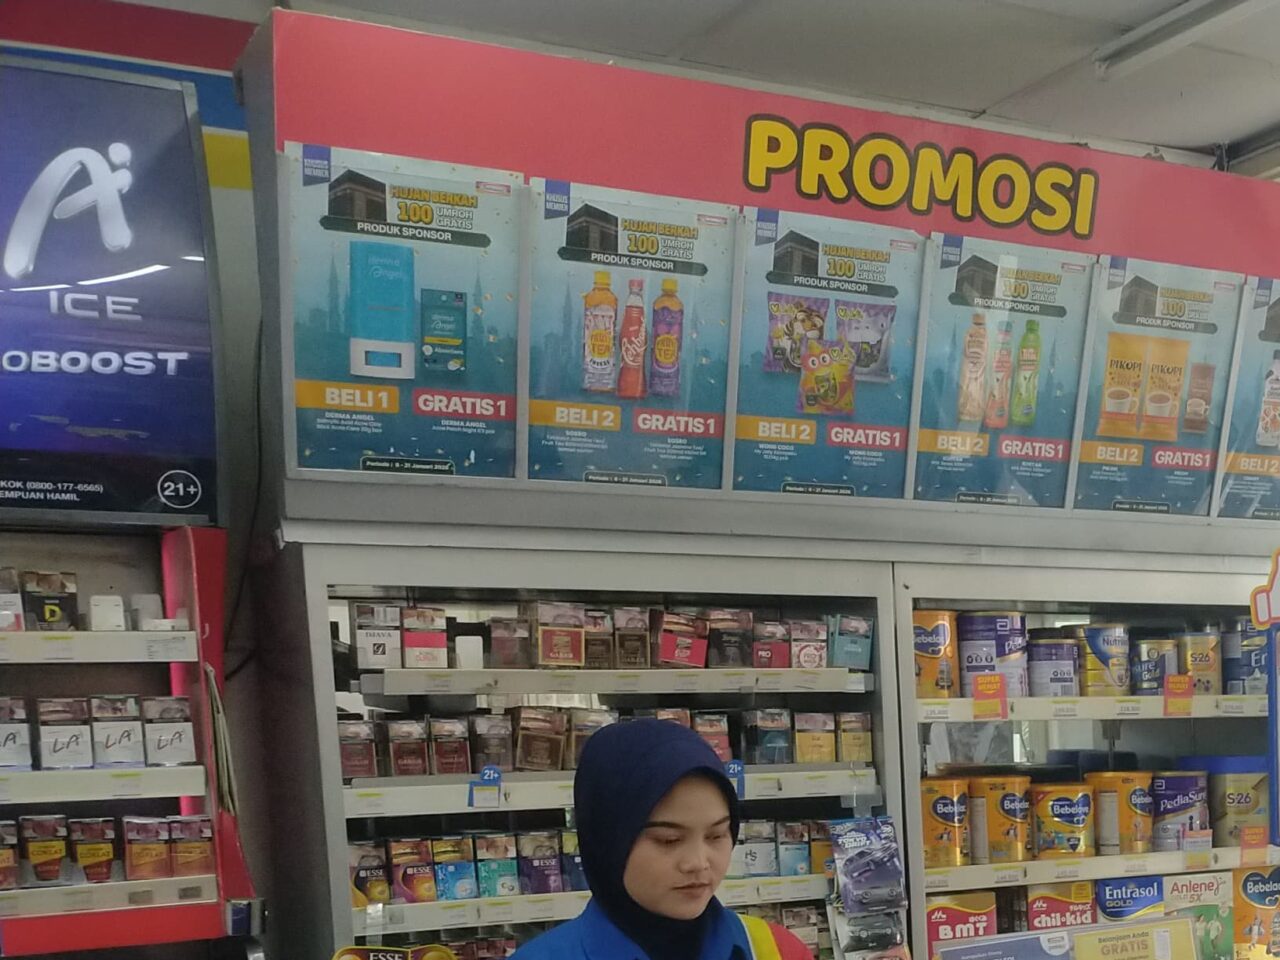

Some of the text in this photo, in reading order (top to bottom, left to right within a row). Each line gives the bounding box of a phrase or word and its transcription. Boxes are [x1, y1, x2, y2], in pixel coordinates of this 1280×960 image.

[743, 114, 1099, 239] PROMOSI
[389, 185, 478, 208] HUJAN BERKAH
[398, 202, 435, 225] 100
[436, 206, 474, 219] UMROH
[357, 221, 452, 242] PRODUK SPONSOR
[436, 217, 473, 229] GRATIS
[621, 218, 698, 239] HUJAN BERKAH
[628, 234, 659, 255] 100
[661, 247, 693, 259] GRATIS
[591, 252, 674, 270] PRODUK SPONSOR
[827, 257, 855, 278] 100
[794, 275, 868, 293] PRODUK SPONSOR
[857, 271, 885, 282] GRATIS
[50, 290, 143, 321] ICE
[974, 297, 1041, 313] PRODUK SPONSOR
[1161, 300, 1186, 318] 100
[1136, 316, 1195, 330] PRODUK SPONSOR
[325, 386, 389, 408] BELI 1
[417, 393, 507, 416] GRATIS 1
[555, 406, 615, 427] BELI 2
[637, 413, 716, 434] GRATIS 1
[758, 421, 811, 440] BELI 2
[830, 427, 900, 447] GRATIS 1
[937, 435, 984, 452] BELI 2
[1001, 440, 1064, 459] GRATIS 1
[1097, 445, 1139, 462] BELI 2
[1155, 450, 1212, 468] GRATIS 1
[1240, 457, 1279, 472] BELI 2
[47, 492, 81, 501] HAMIL
[163, 482, 198, 497] 21+
[43, 603, 62, 622] D
[484, 769, 499, 780] 21+
[728, 764, 743, 774] 21+
[1053, 804, 1089, 815] Bebelove
[413, 866, 432, 875] ESSE
[539, 859, 557, 867] ESSE
[1105, 882, 1158, 900] Entrasol
[1170, 878, 1214, 896] Anlene
[938, 921, 987, 939] BMT
[1101, 941, 1149, 956] GRATIS
